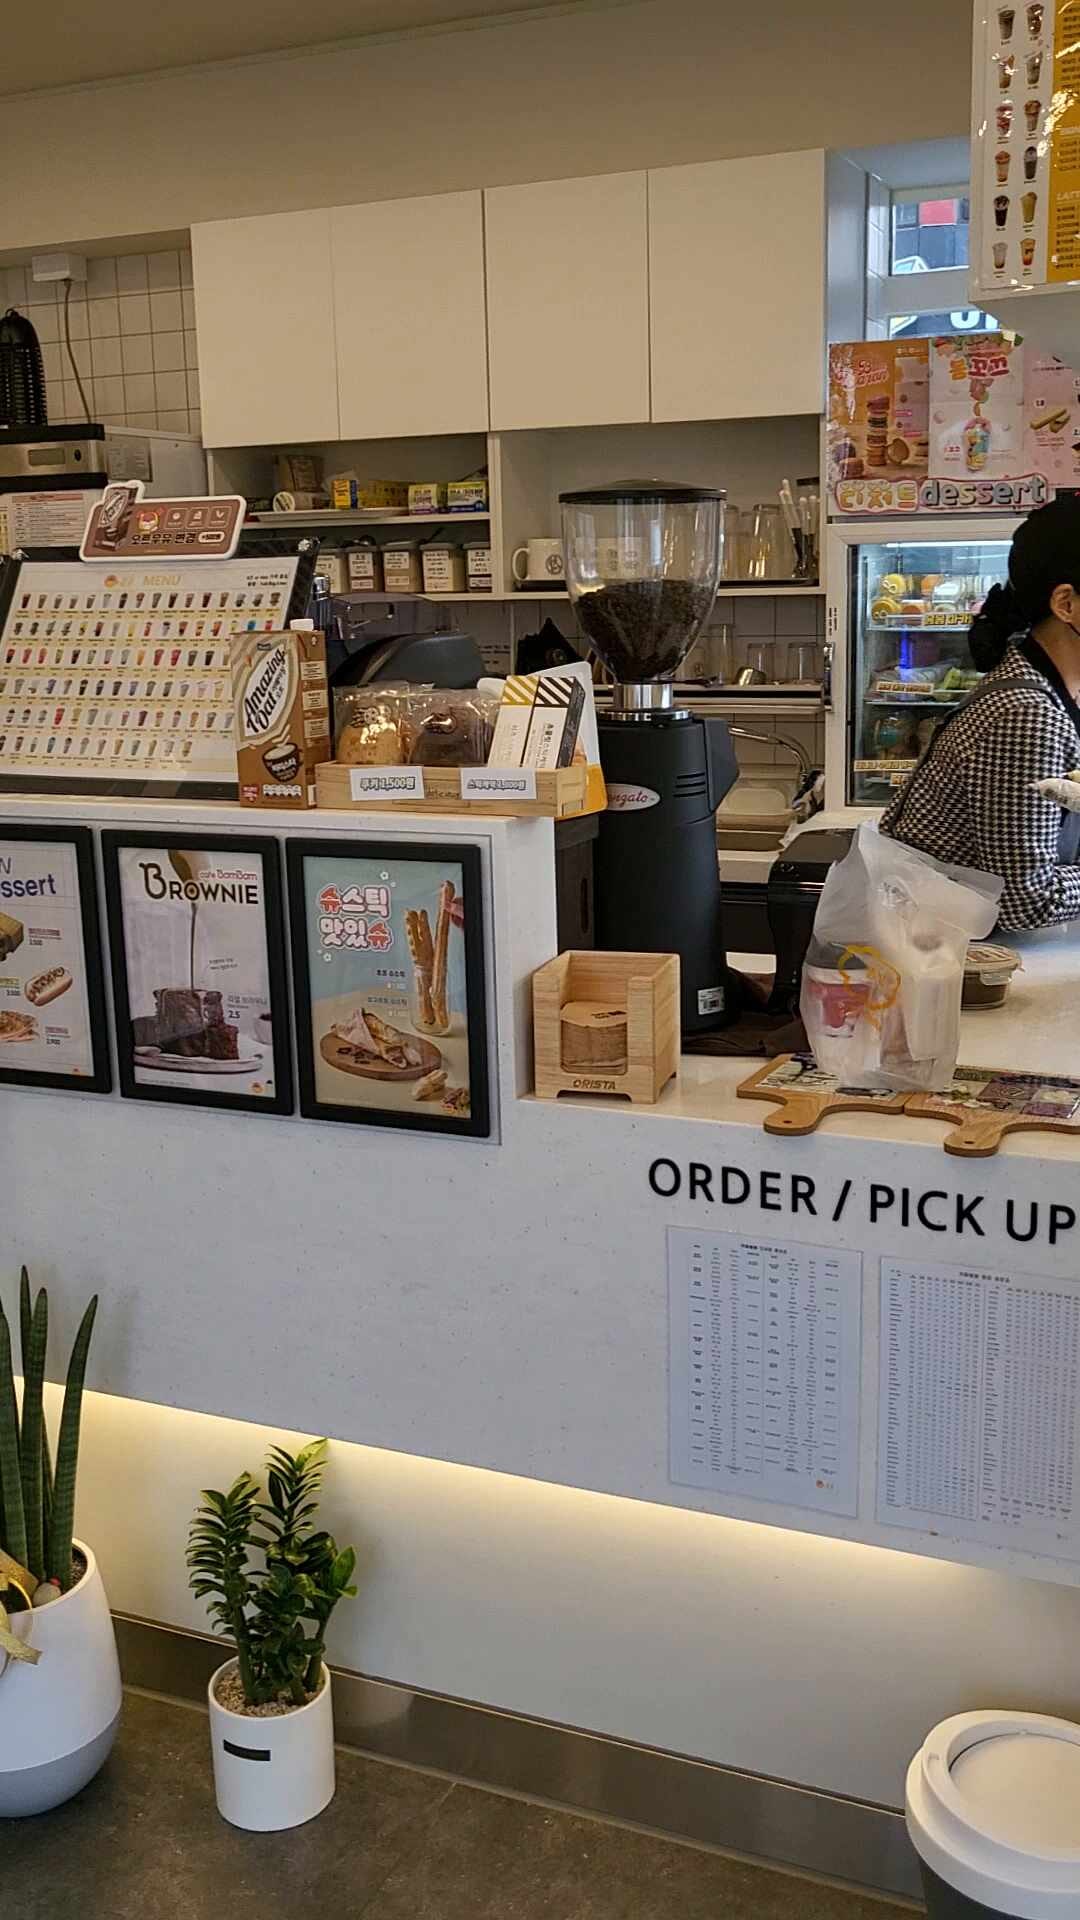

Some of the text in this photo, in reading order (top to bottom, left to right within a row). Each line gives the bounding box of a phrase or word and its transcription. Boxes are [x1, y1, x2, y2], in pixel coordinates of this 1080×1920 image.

[922, 476, 1045, 506] dessert
[244, 648, 286, 733] Amazing
[255, 691, 277, 730] Oat
[138, 862, 259, 905] BROWNIE
[319, 885, 388, 918] 슈스틱
[319, 917, 390, 949] 맛있슈
[648, 1158, 1077, 1245] ORDER / PICK UP
